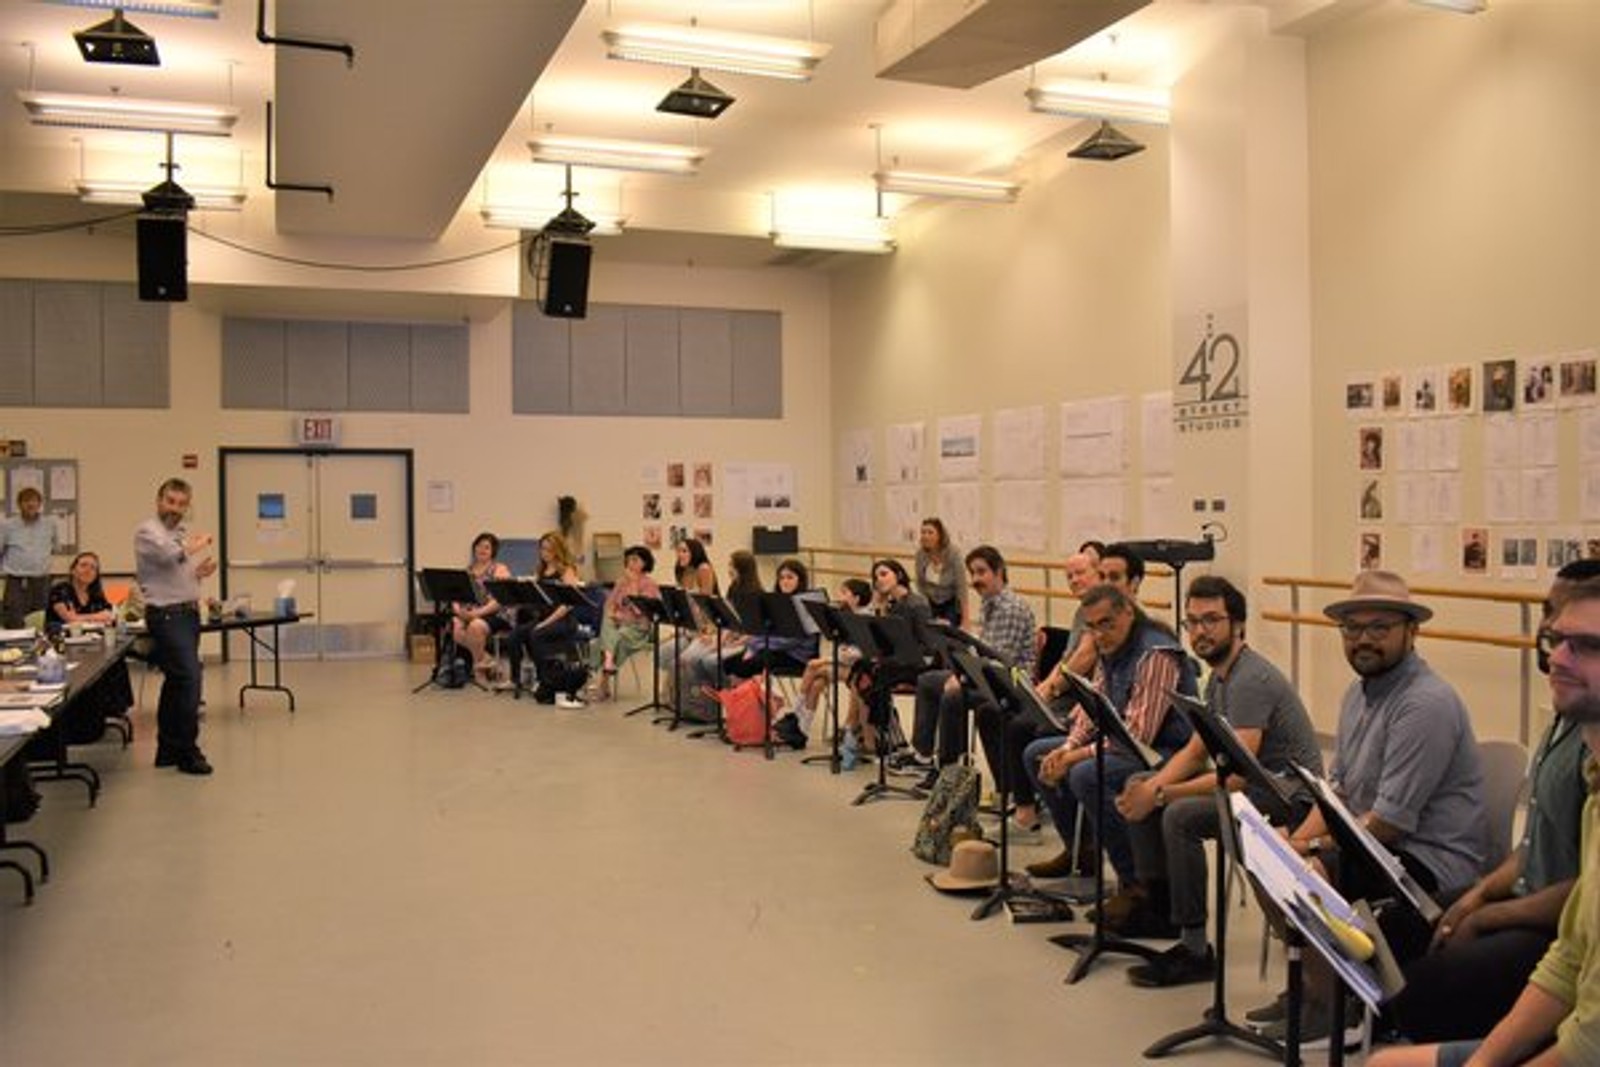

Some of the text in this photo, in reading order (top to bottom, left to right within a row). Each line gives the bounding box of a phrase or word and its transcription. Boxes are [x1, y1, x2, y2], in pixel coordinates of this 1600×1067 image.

[1179, 333, 1239, 402] 42
[304, 419, 331, 440] EXIT
[1179, 418, 1240, 432] STUDIOS
